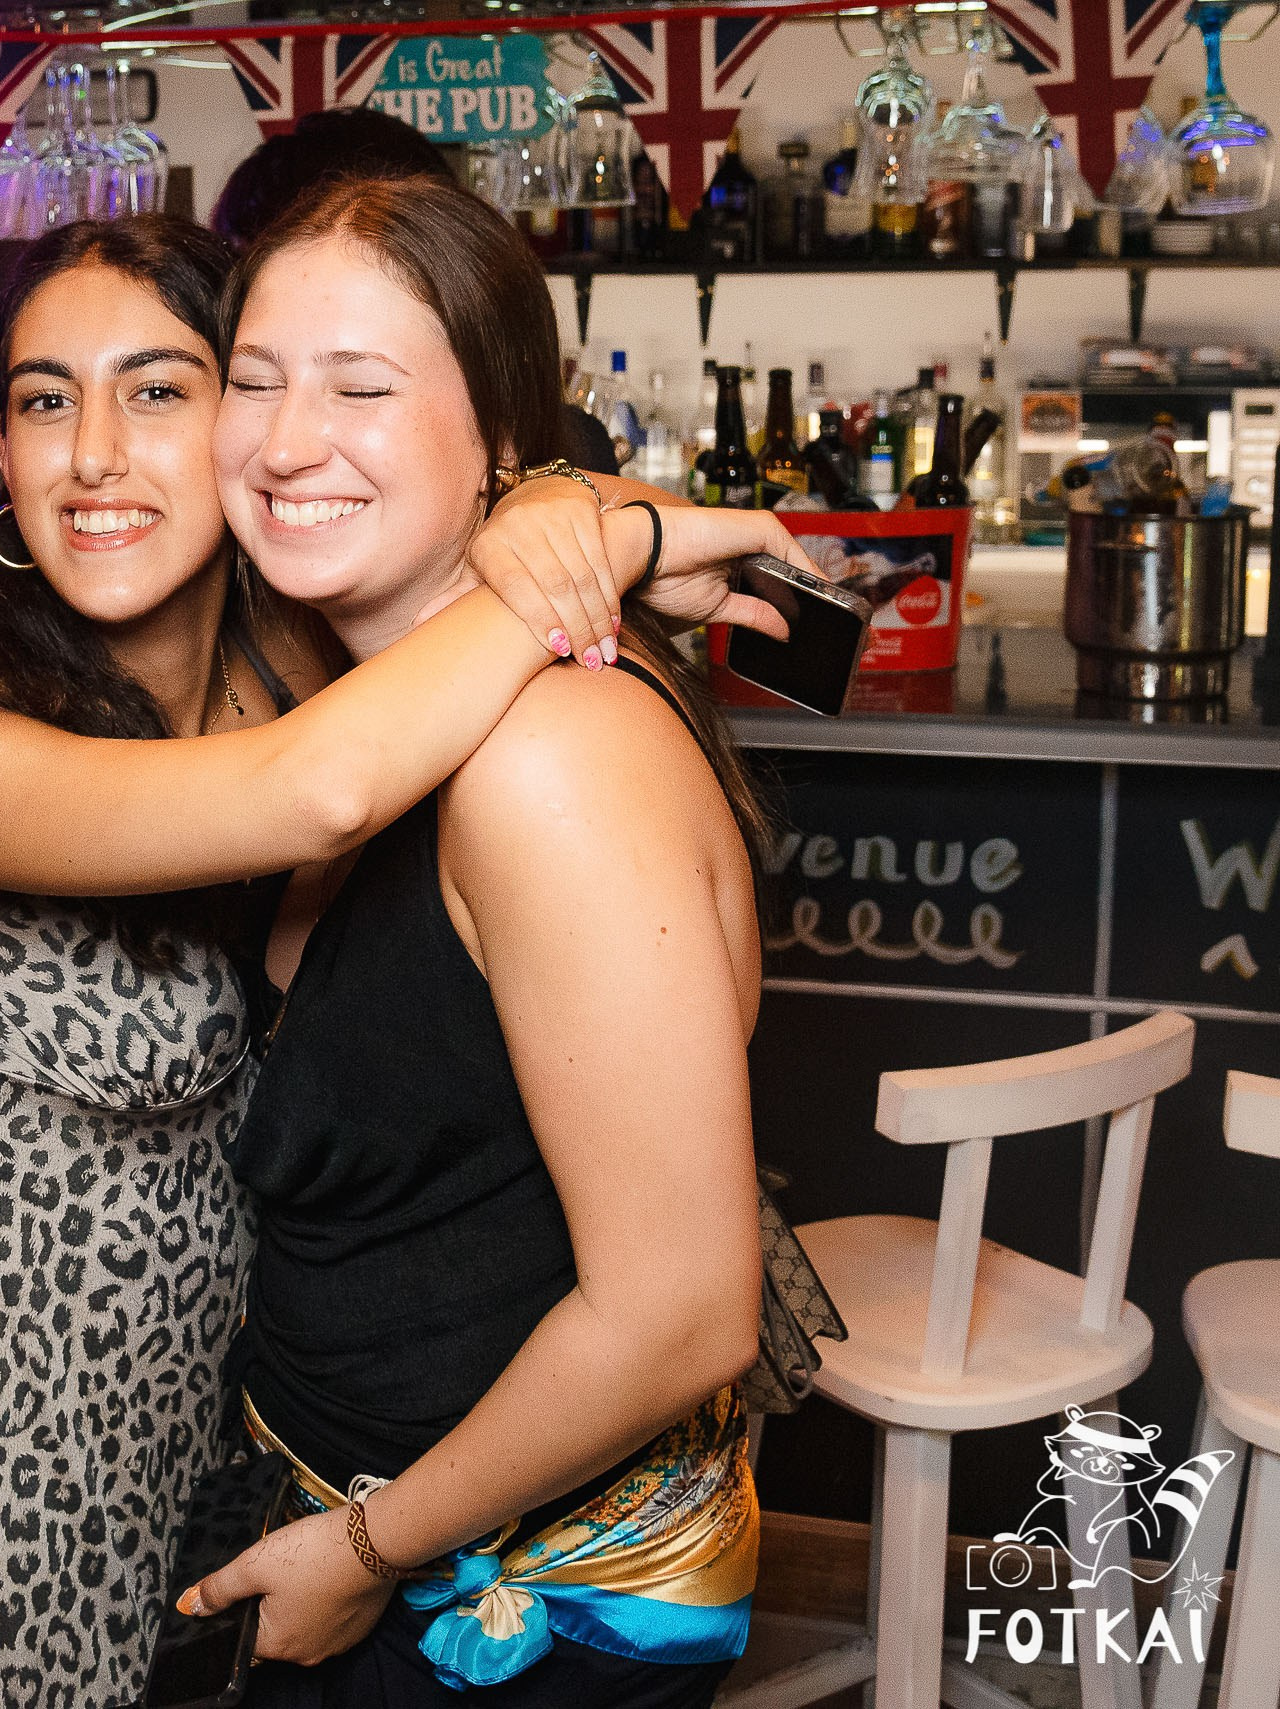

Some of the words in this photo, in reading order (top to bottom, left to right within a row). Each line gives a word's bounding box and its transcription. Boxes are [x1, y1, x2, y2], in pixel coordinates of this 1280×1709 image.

[398, 55, 418, 82] is
[426, 40, 504, 83] Great
[449, 85, 539, 132] PUB
